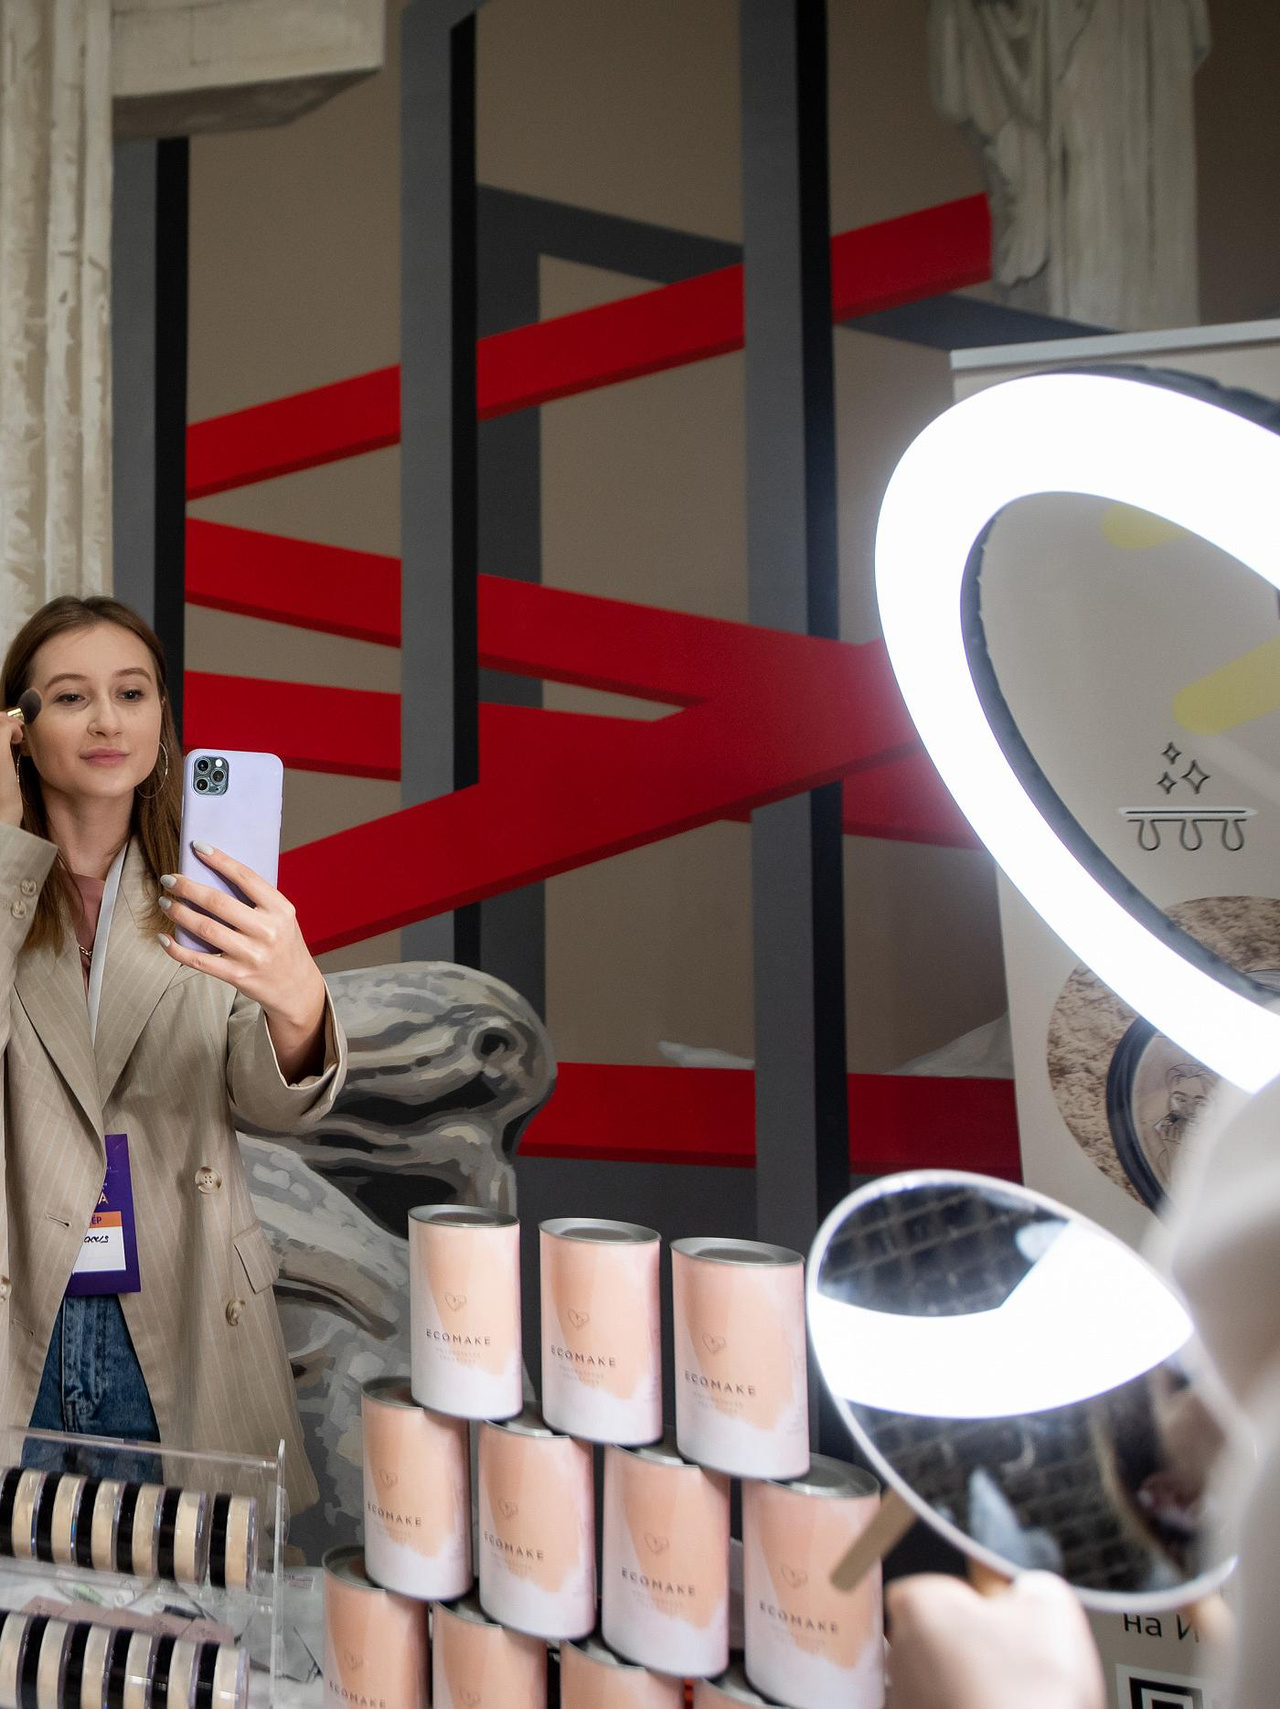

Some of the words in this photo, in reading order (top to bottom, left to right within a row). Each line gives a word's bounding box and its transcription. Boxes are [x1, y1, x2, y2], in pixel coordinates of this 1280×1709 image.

[426, 1328, 491, 1346] ECOMAKE
[550, 1345, 616, 1367] ECOMAKE
[684, 1369, 757, 1397] ECOMAKE
[367, 1501, 422, 1529] ECOMAKE
[484, 1531, 545, 1560] ECOMAKE
[621, 1566, 697, 1597] ECOMAKE
[759, 1601, 839, 1634] ECOMAKE
[1123, 1613, 1162, 1638] на
[1177, 1613, 1199, 1643] И
[329, 1680, 386, 1709] ECOMAKE
